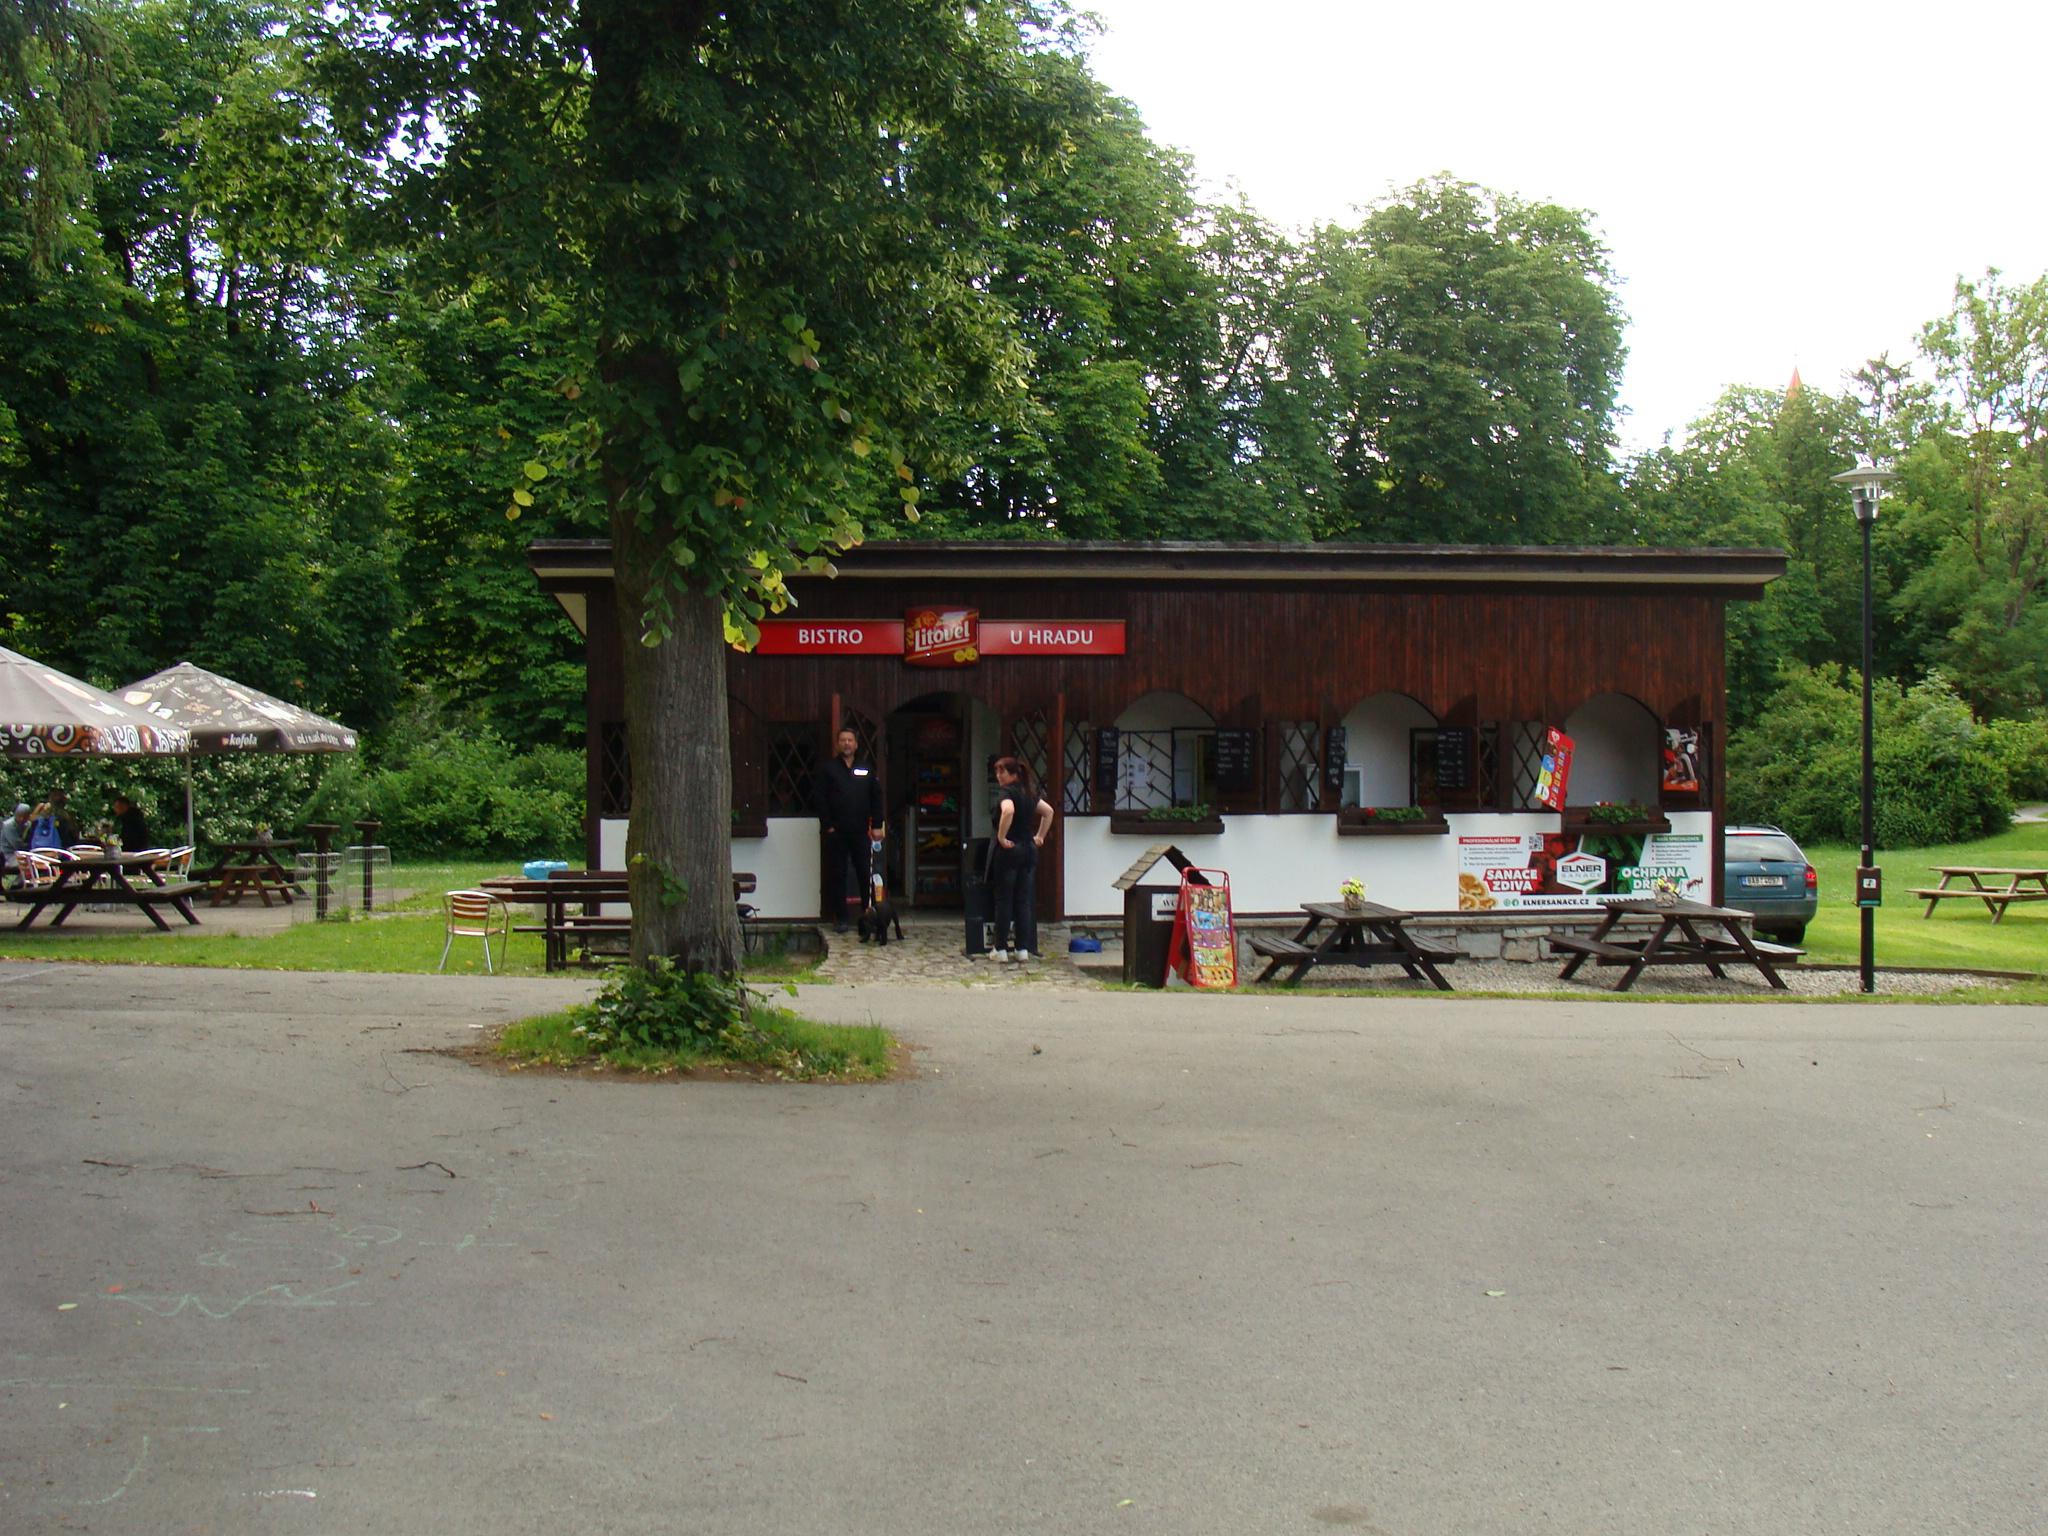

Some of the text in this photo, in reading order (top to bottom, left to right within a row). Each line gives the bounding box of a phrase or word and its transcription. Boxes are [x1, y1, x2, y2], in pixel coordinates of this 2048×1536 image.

[799, 629, 863, 644] BISTRO
[915, 620, 970, 652] Litovel
[1010, 629, 1093, 645] U HRADU
[229, 733, 258, 749] kofola
[1486, 869, 1538, 880] SANACE
[1561, 864, 1602, 873] ELNER
[1621, 866, 1685, 878] OCHRANA
[1493, 881, 1533, 890] ZDIVA
[1522, 898, 1589, 906] ELNERSANACE.CZ
